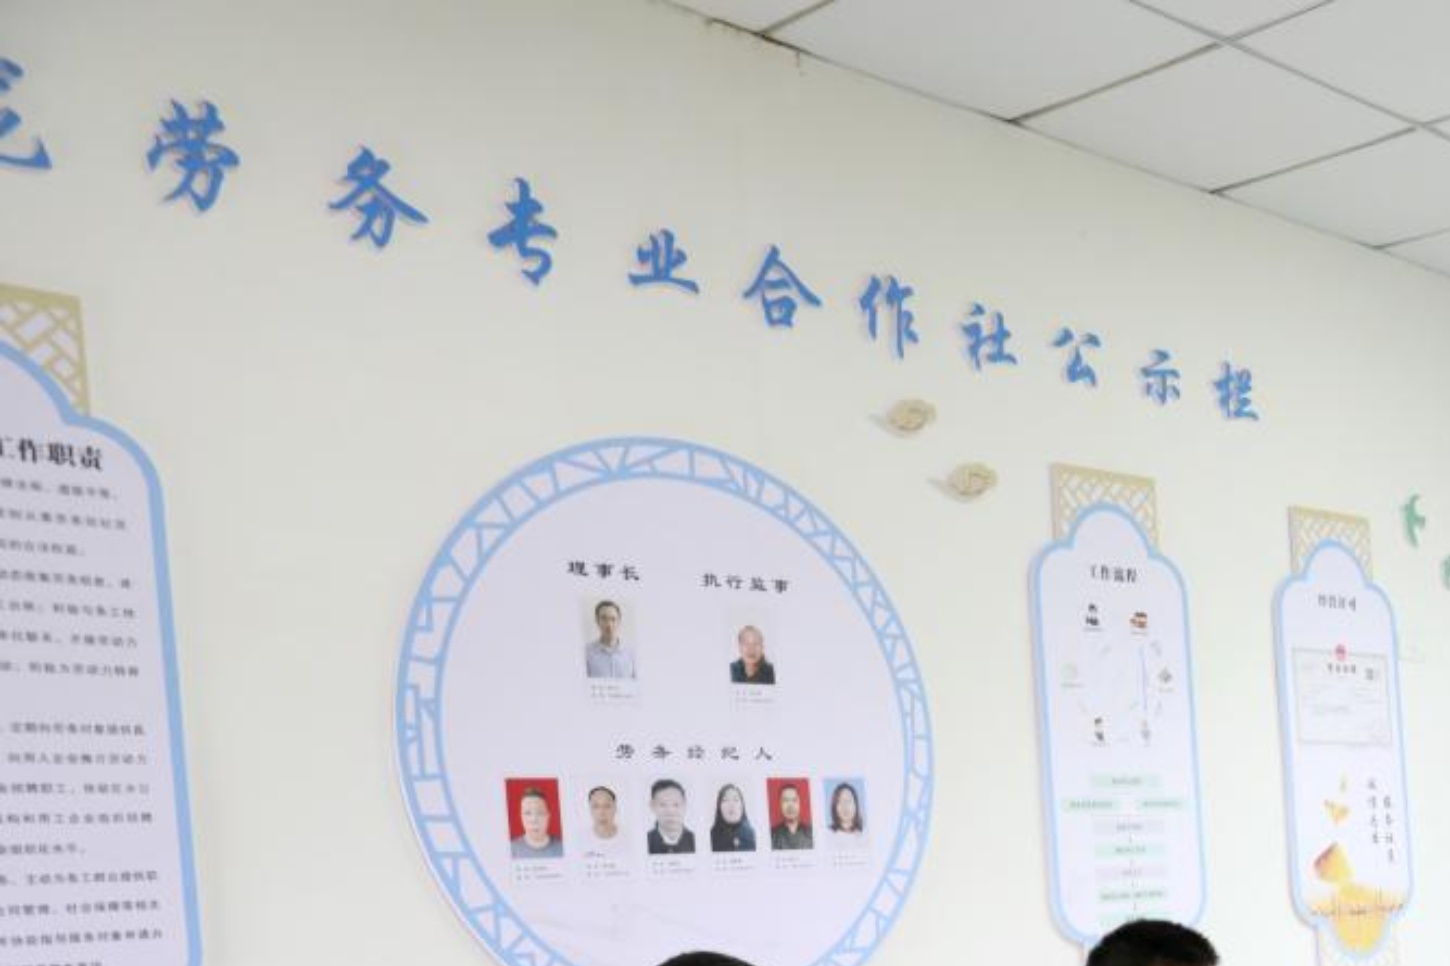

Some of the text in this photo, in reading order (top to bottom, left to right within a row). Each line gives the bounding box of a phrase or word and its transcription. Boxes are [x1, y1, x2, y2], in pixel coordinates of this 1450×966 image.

[566, 560, 641, 582] 理事长
[700, 572, 790, 594] 执行监事
[615, 743, 773, 762] 劳务经纪人
